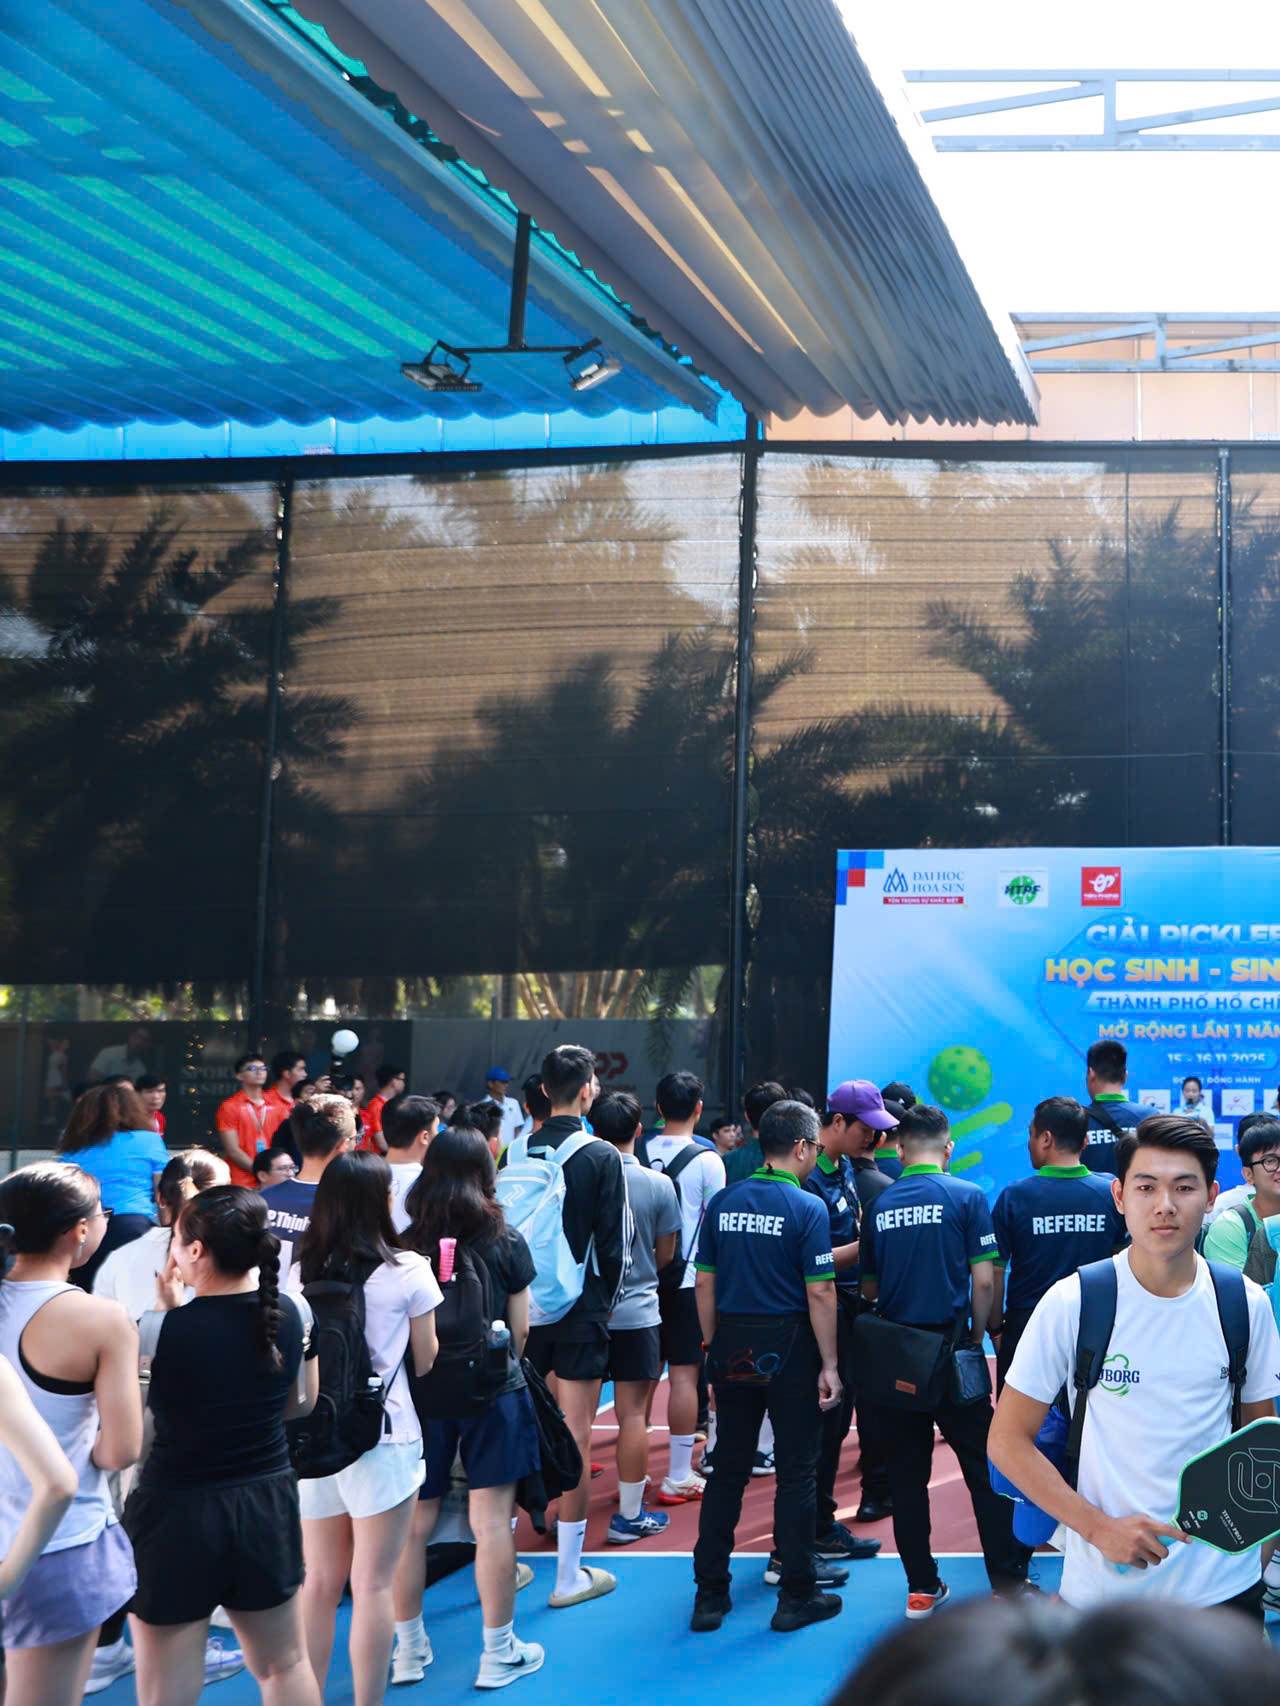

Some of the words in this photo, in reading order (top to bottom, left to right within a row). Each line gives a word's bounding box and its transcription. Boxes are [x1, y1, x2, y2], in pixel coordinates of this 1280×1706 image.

[912, 882, 940, 894] HOA
[942, 882, 965, 894] SEN
[1086, 916, 1149, 944] GIẢI
[1045, 958, 1116, 988] HỌC
[1125, 958, 1200, 982] SINH
[1096, 993, 1162, 1009] THÀNH
[1169, 992, 1209, 1009] PHỐ
[1250, 992, 1280, 1009] CHÍ
[1099, 1019, 1129, 1039] MỞ
[1134, 1020, 1187, 1041] RỘNG
[1234, 1023, 1242, 1039] 1
[719, 1212, 785, 1236] REFEREE
[876, 1204, 944, 1232] REFEREE
[1032, 1214, 1106, 1235] REFEREE
[1222, 1510, 1234, 1528] TITAN
